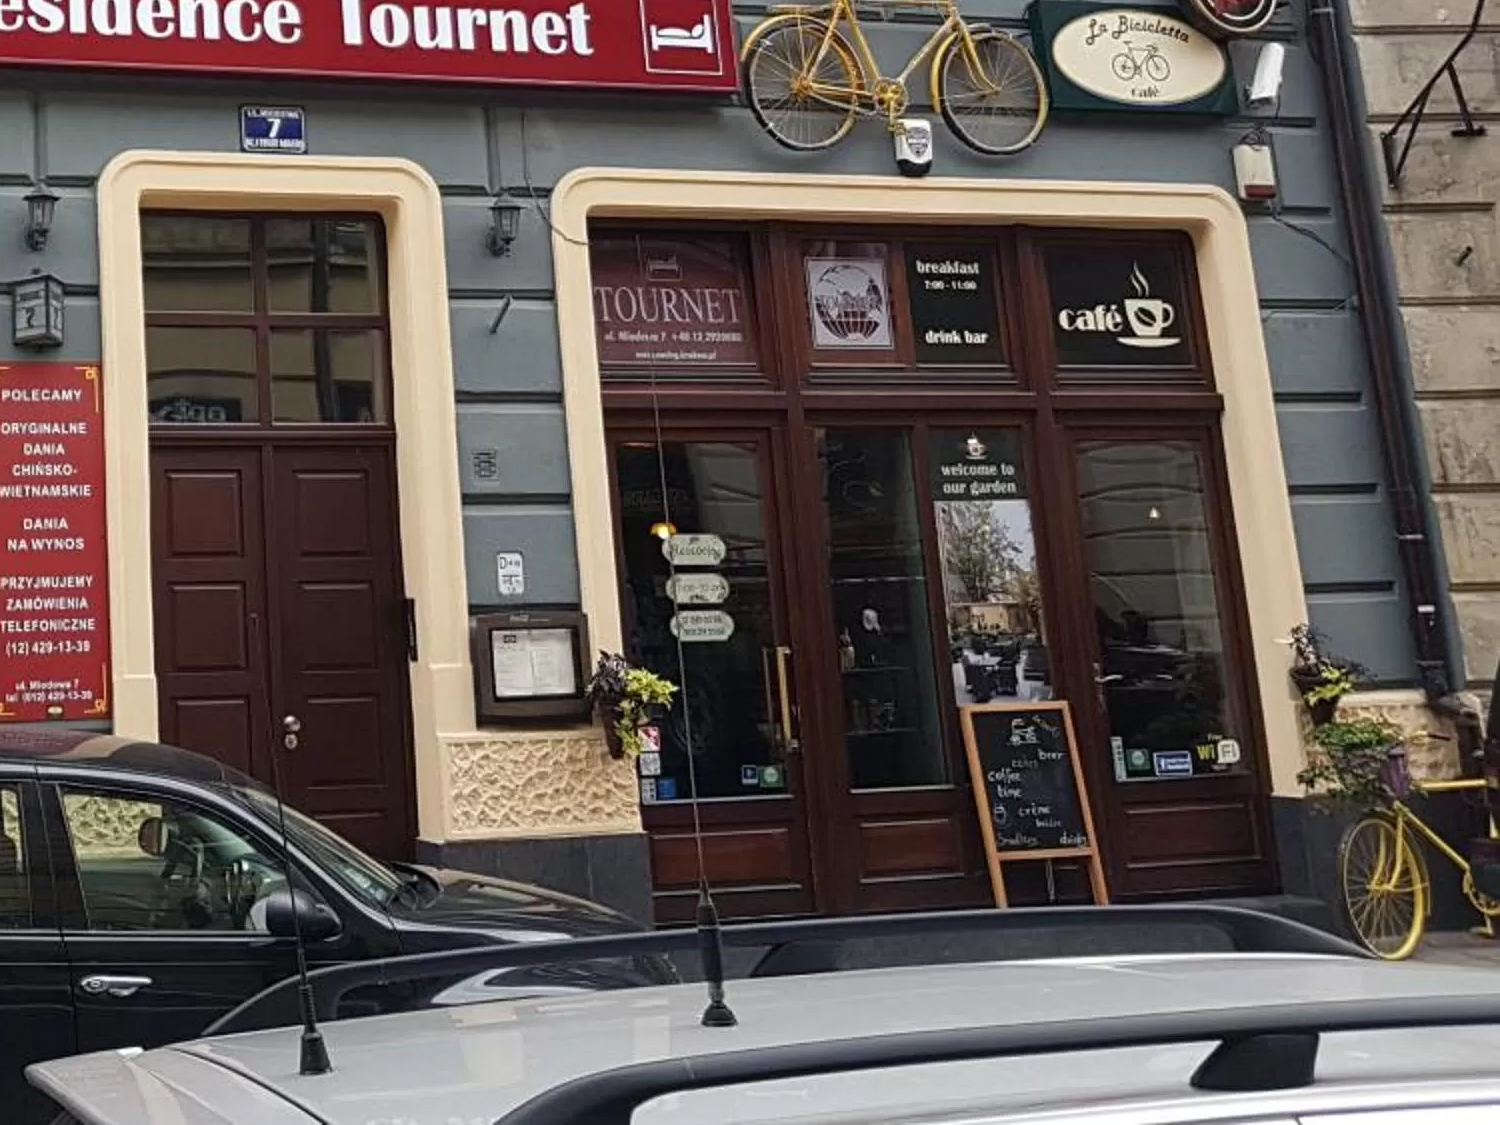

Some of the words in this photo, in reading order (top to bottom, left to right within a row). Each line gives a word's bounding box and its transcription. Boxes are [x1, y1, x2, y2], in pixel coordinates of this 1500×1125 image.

[1085, 18, 1108, 45] La
[1111, 15, 1190, 43] Bicicletta
[266, 118, 281, 138] 7
[915, 260, 980, 275] breakfast
[594, 286, 741, 323] TOURNET
[1058, 304, 1123, 332] café
[925, 330, 962, 344] drink
[963, 330, 988, 344] bar
[1, 389, 82, 401] POLECAMY
[1, 422, 88, 435] ORYGINALNE
[23, 443, 65, 456] DANIA
[12, 461, 77, 476] CHIŃSKO-
[940, 463, 998, 476] welcome
[1001, 463, 1015, 475] to
[943, 482, 967, 494] our
[969, 480, 1017, 496] garden
[23, 518, 68, 530] DANIA
[7, 539, 28, 551] NA
[31, 538, 85, 550] WYNOS
[0, 576, 93, 590] PRZYJMUJEMY
[5, 597, 88, 611] ZAMÓWIENIA
[0, 618, 95, 633] TELEFONICZNE
[5, 642, 29, 657] (12)
[31, 640, 91, 654] 429-13-39
